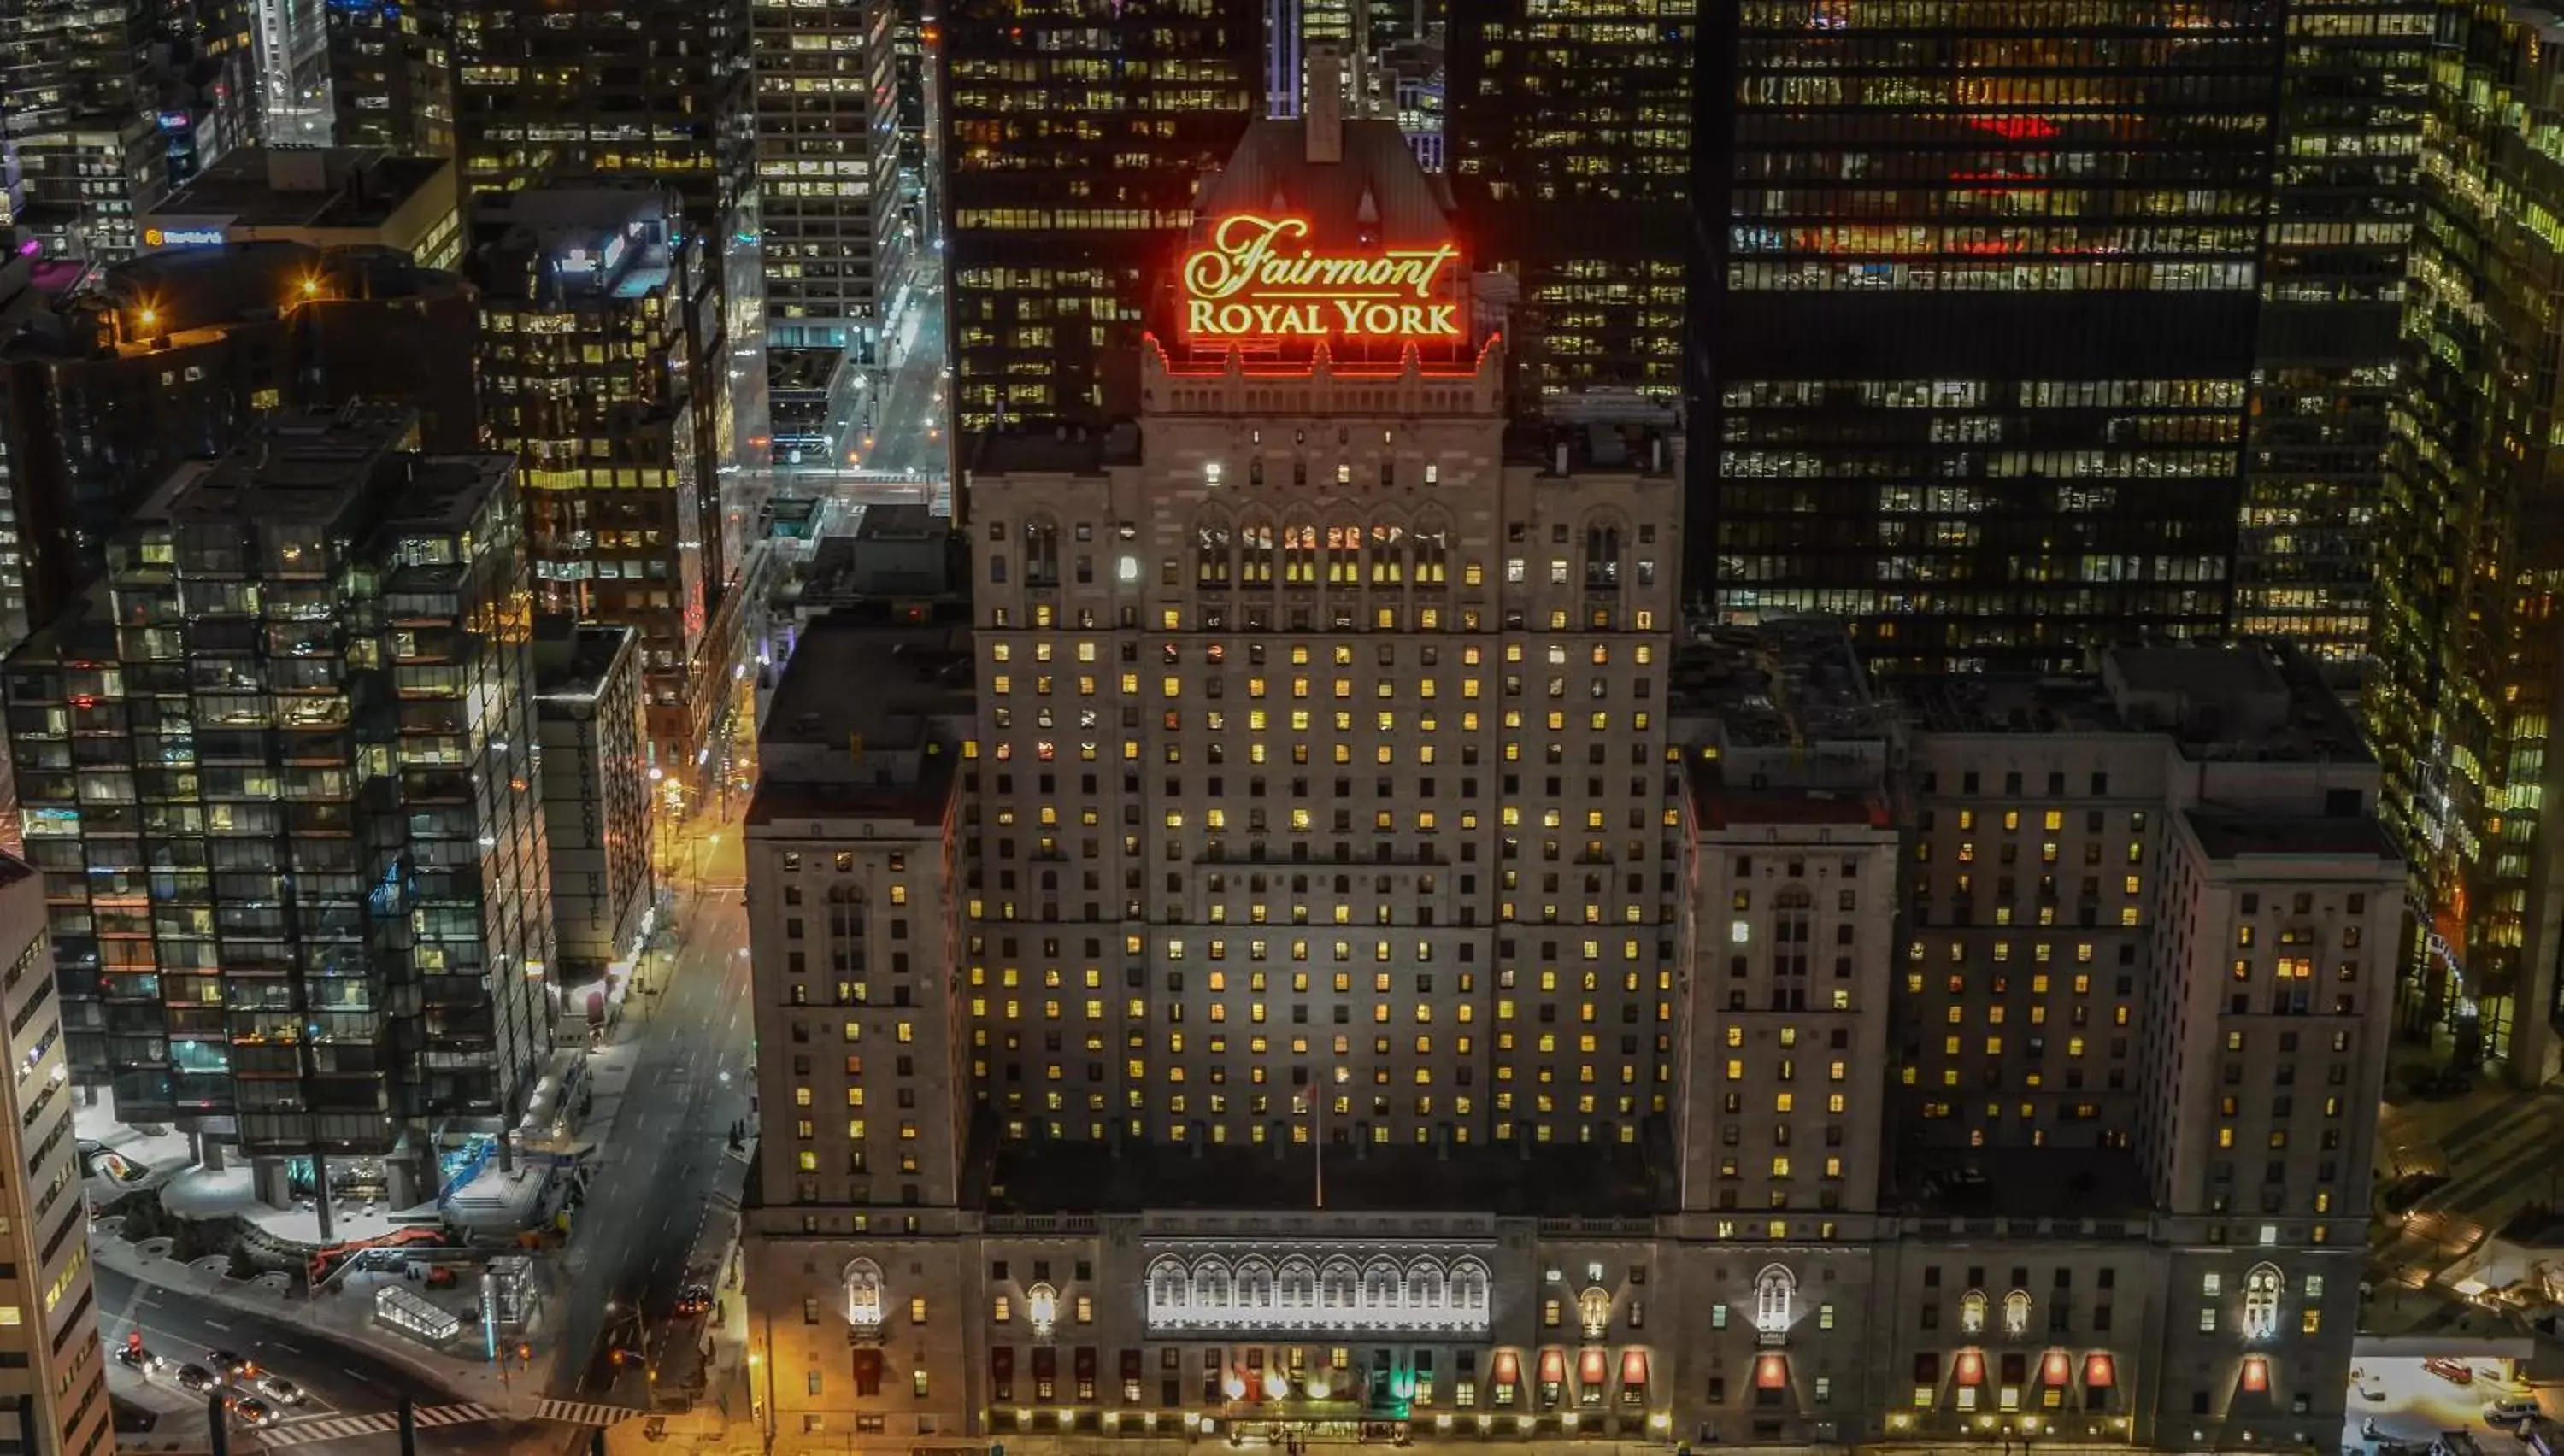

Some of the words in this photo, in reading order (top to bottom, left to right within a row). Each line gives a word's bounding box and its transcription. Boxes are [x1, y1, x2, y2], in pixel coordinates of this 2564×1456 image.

[1185, 214, 1461, 299] Fairmont
[1187, 300, 1328, 335] ROYAL
[1334, 299, 1460, 335] YORK
[586, 872, 601, 931] HOTEL
